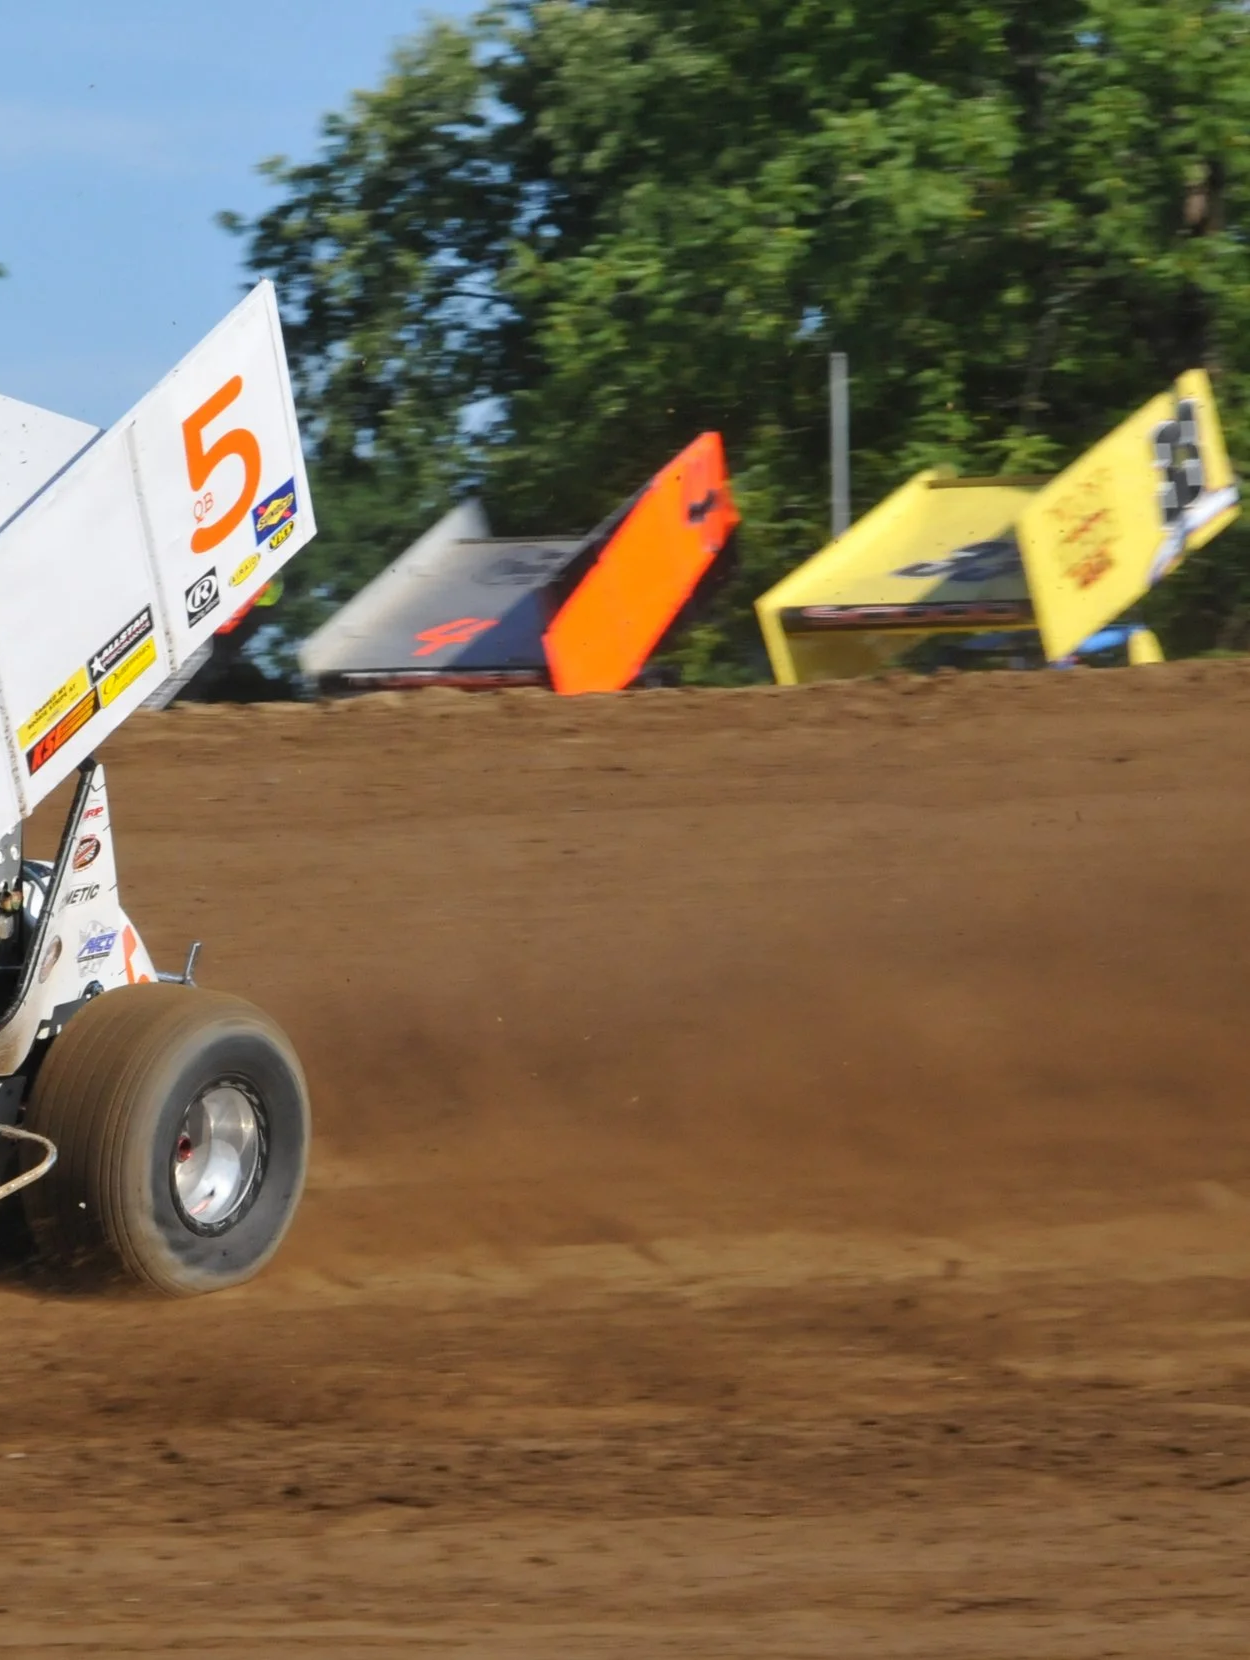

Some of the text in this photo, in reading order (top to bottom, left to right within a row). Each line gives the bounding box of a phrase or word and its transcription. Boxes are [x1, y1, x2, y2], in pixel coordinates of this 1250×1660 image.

[182, 375, 261, 553] 5
[193, 492, 214, 524] QB
[101, 610, 149, 660] ALLSTAR
